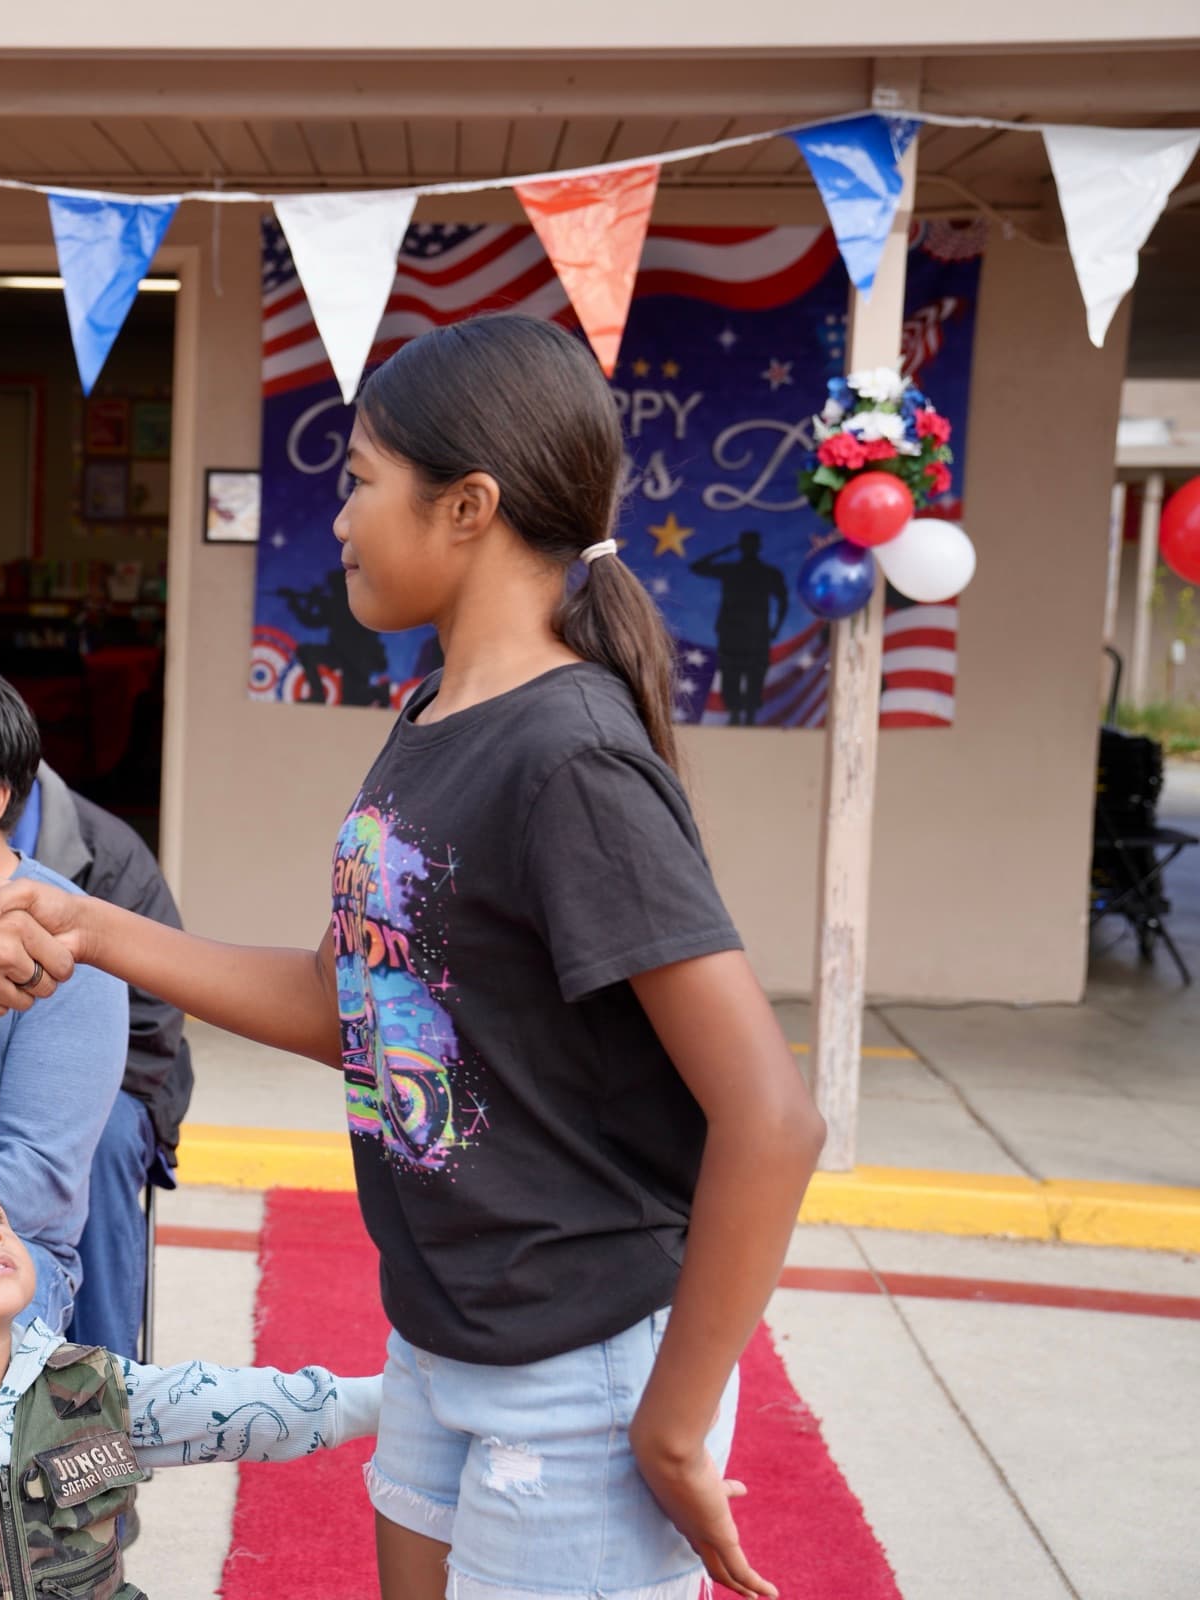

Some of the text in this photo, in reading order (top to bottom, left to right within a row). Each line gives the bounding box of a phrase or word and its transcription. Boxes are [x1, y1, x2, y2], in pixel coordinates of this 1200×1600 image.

[333, 843, 377, 912] arley-
[53, 1441, 127, 1481] JUNGLE
[61, 1462, 135, 1497] SAFARI GUIDE
